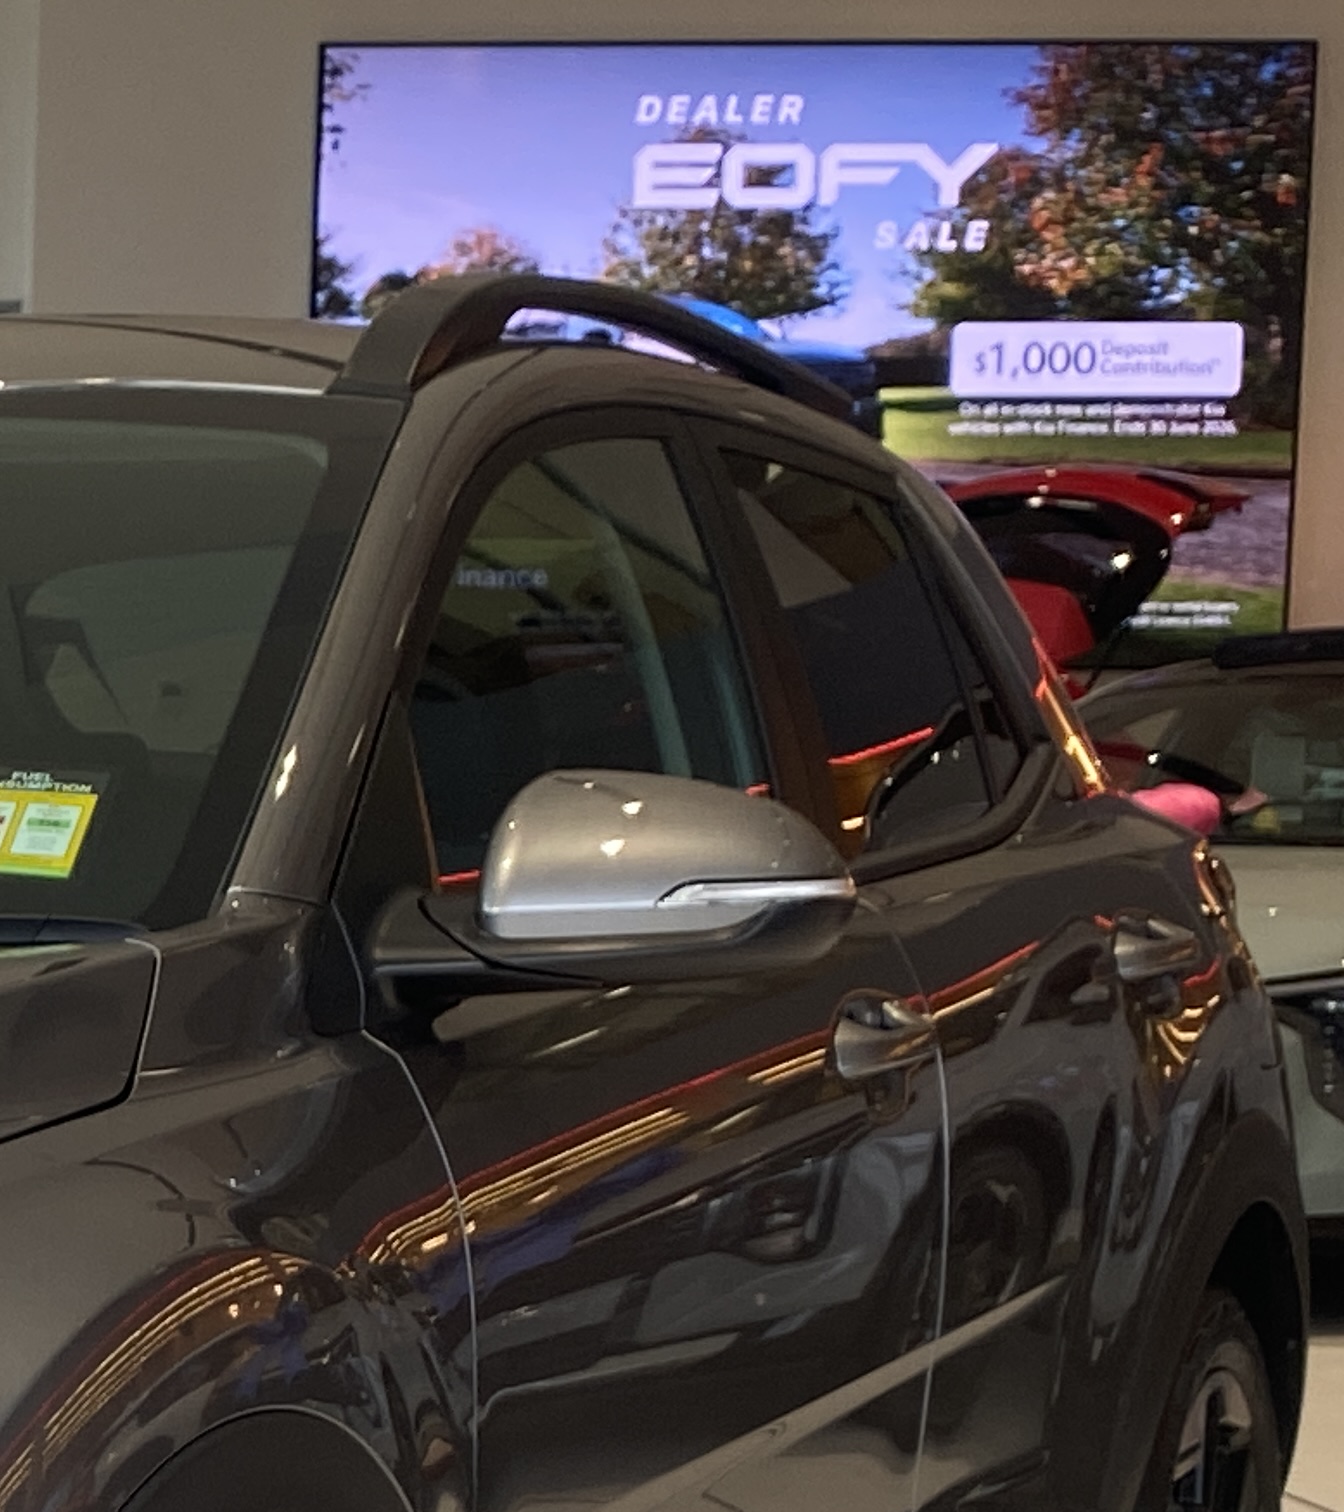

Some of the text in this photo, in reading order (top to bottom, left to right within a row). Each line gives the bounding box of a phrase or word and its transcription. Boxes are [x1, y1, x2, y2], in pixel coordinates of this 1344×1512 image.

[634, 94, 805, 125] DEALER
[632, 142, 999, 209] EOFY
[874, 219, 990, 251] SALE
[974, 341, 1096, 379] $1,000
[1101, 339, 1169, 357] Deposit
[456, 563, 549, 588] inance
[11, 771, 54, 782] FUEL
